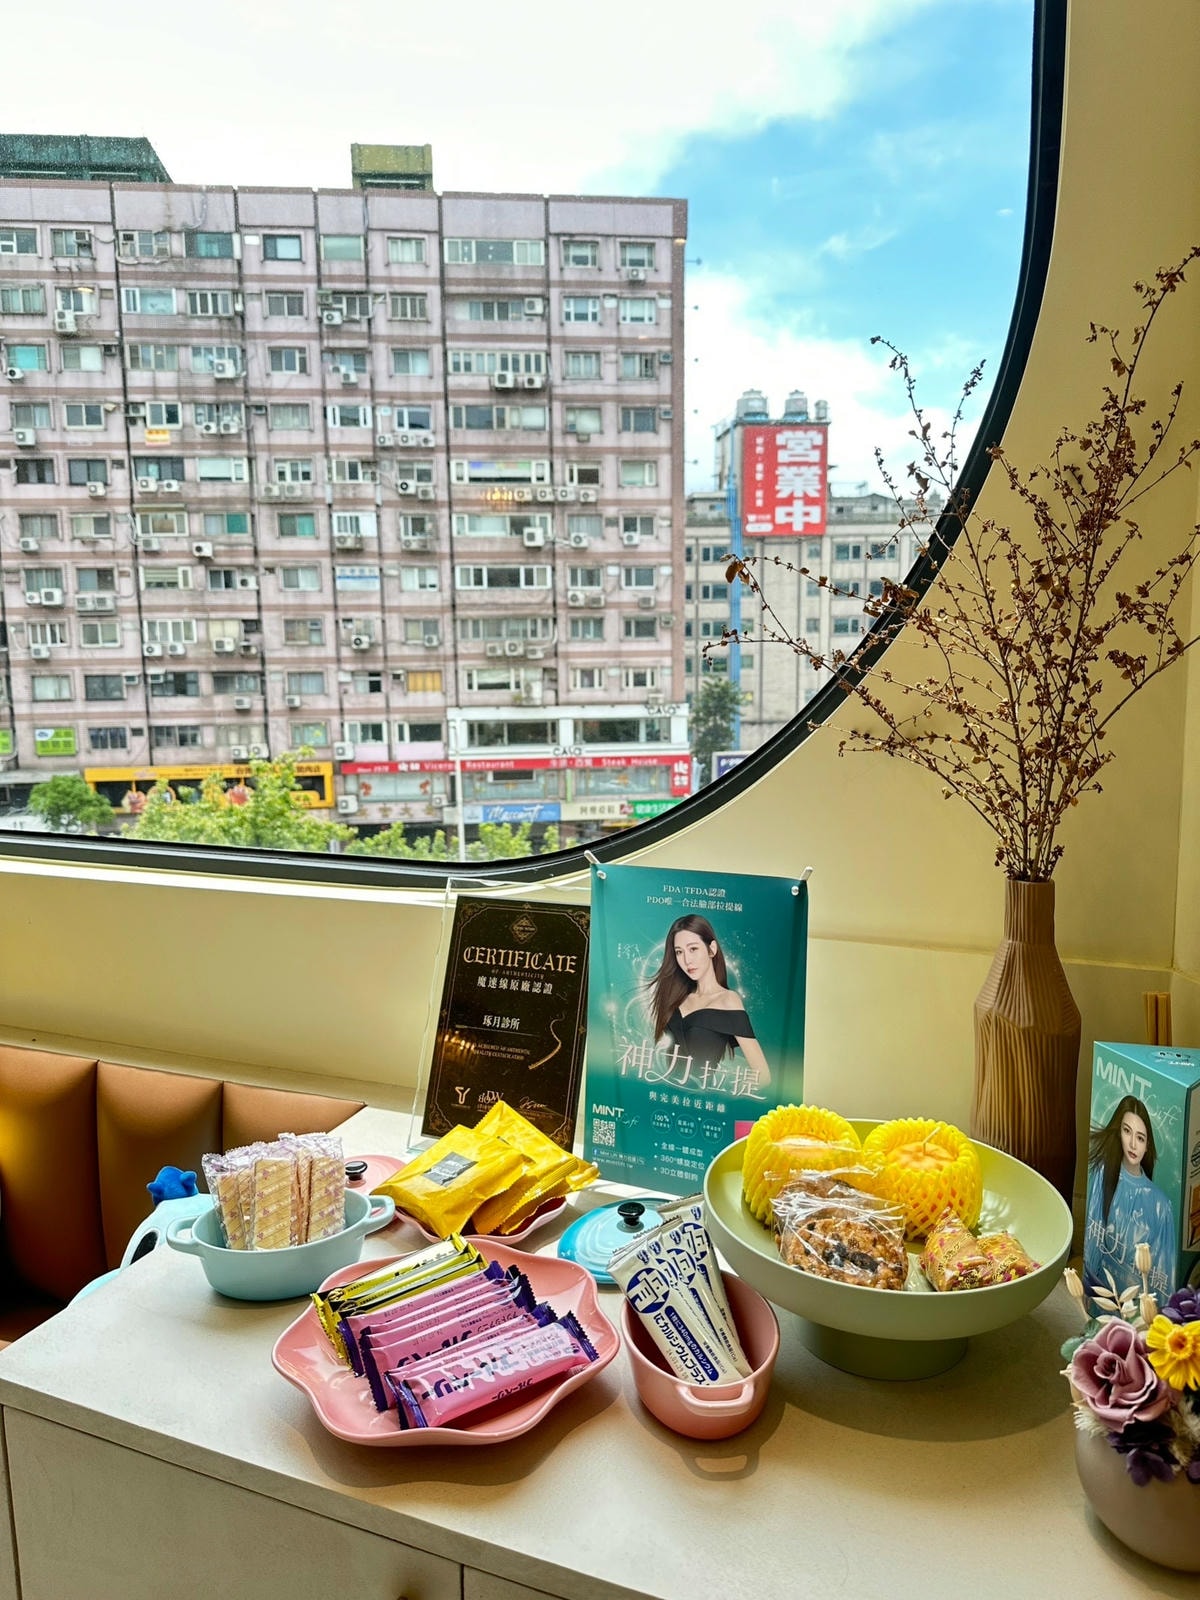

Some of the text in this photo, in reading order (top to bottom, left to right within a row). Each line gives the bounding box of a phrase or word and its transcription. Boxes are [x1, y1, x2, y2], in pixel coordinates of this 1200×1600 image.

[775, 430, 823, 532] 營業中
[463, 945, 578, 974] CERTIFICATE
[615, 1036, 767, 1101] 神力拉提
[1095, 1056, 1152, 1103] MINT
[592, 1103, 625, 1118] MINT
[654, 1113, 670, 1122] 100%
[1087, 1215, 1170, 1298] 神力提
[653, 1312, 709, 1386] にカルシウムプラス
